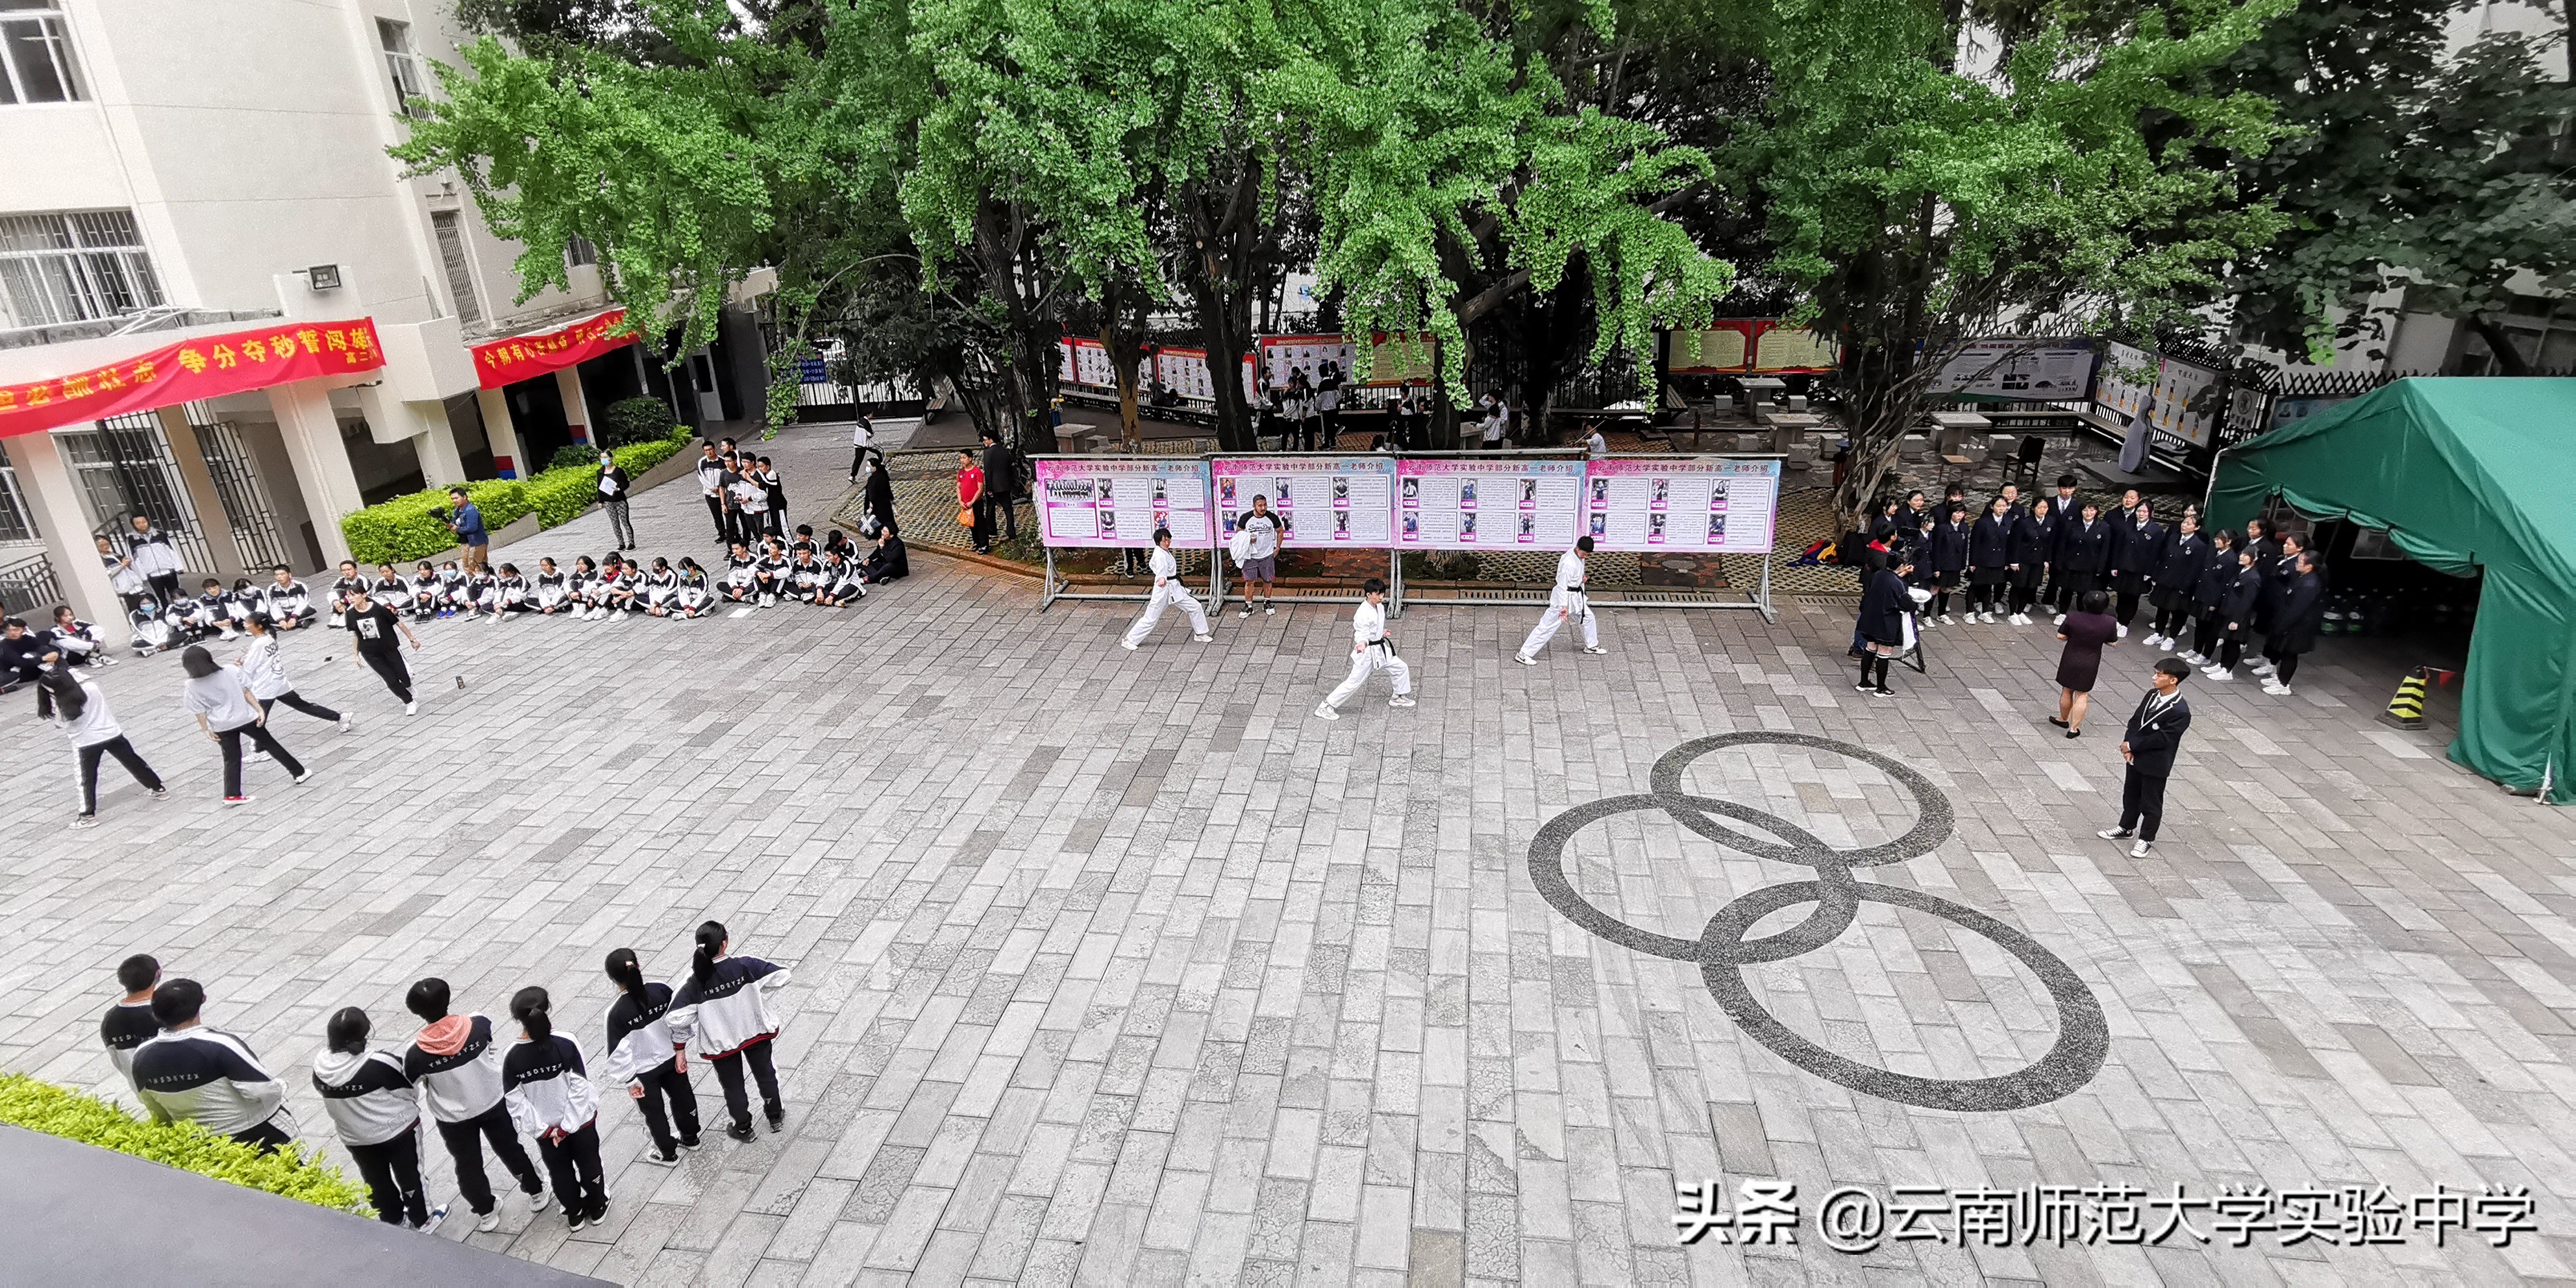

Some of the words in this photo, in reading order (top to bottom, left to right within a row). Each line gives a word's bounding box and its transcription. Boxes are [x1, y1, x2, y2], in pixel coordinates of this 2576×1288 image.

[178, 327, 375, 373] 争分夺秒誓闯雄
[1047, 464, 1200, 472] 云南师范大学实验中学部分新高一老师介绍
[1223, 462, 1384, 471] 云南师范大学实验中学部分新高一老师介绍
[1407, 464, 1574, 472] 云南师范大学实验中学部分新高一老师介绍
[1597, 464, 1769, 473] 云南师范大学实验中学部分新高一老师介绍
[704, 975, 745, 996] YNSDSYZX
[627, 1002, 668, 1026] YNSSYZX
